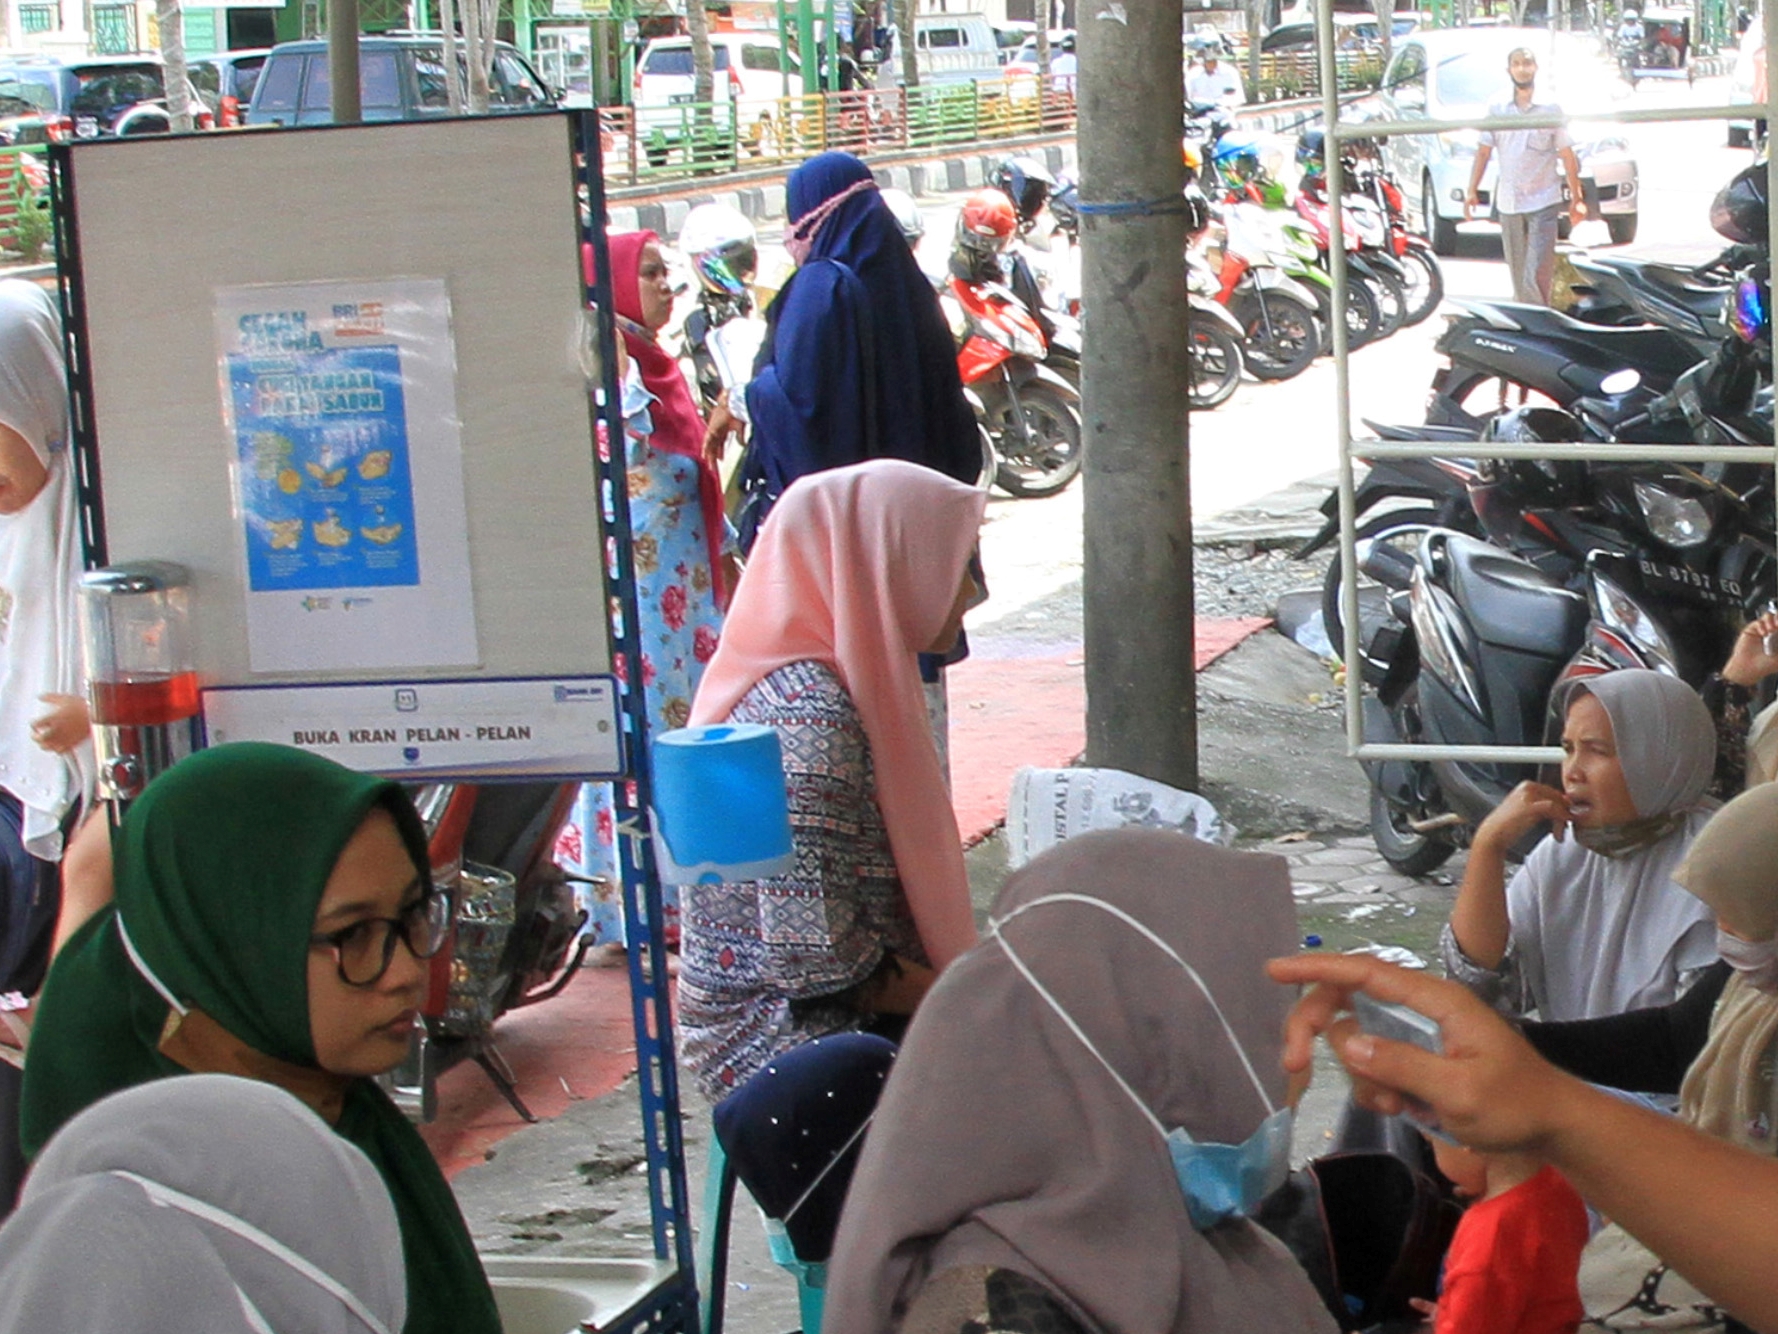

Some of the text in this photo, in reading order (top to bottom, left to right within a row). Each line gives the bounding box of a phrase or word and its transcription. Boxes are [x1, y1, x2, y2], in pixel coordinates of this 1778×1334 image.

[293, 731, 340, 745] BUKA
[349, 729, 397, 743] KRAN
[406, 728, 460, 743] PELAN
[476, 726, 531, 740] PELAN
